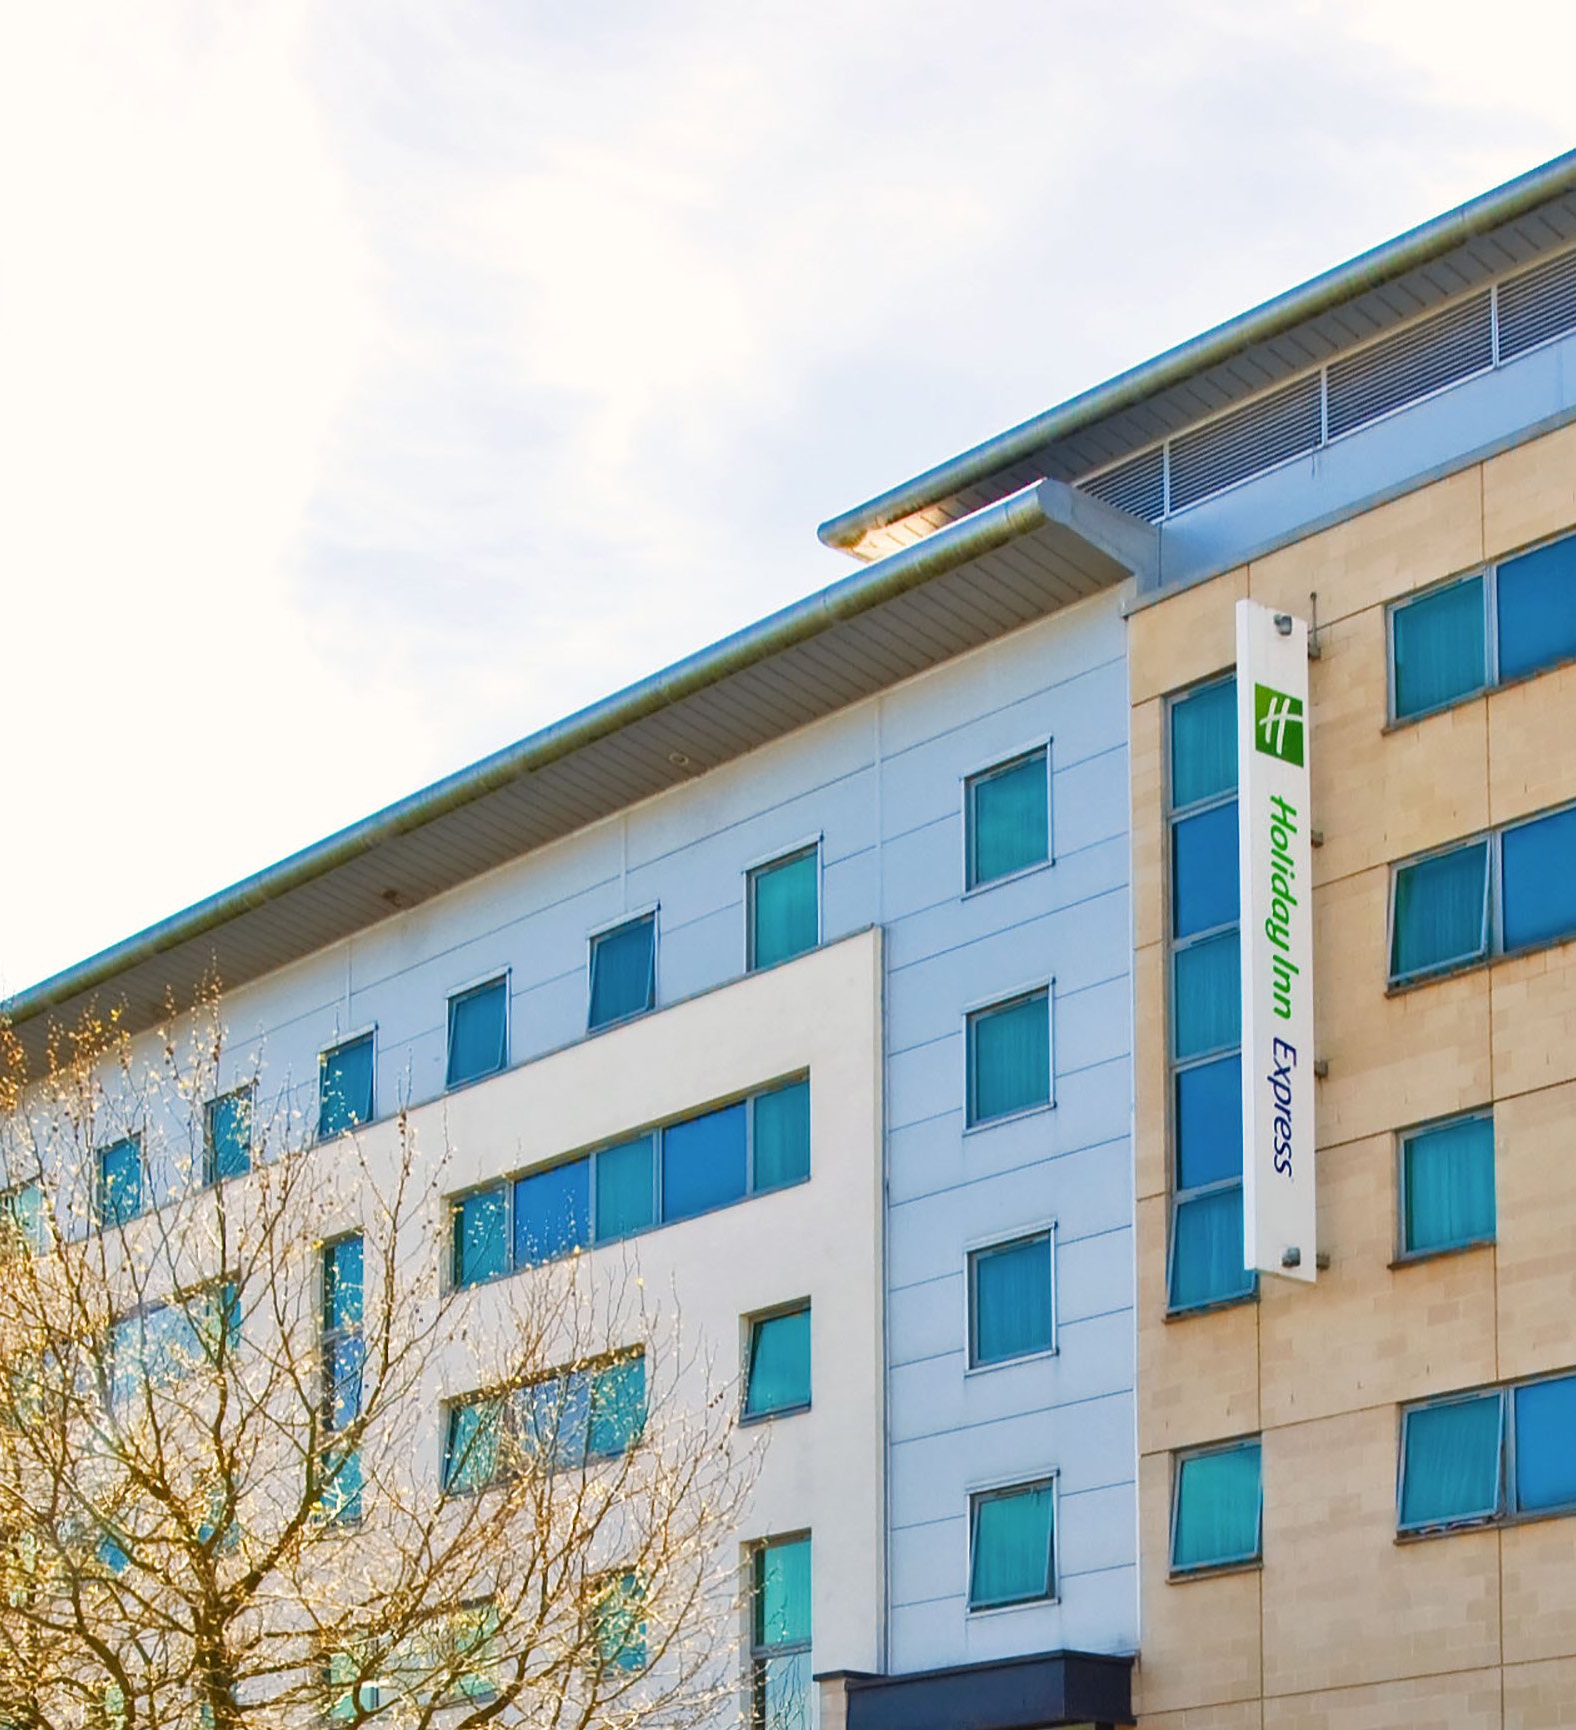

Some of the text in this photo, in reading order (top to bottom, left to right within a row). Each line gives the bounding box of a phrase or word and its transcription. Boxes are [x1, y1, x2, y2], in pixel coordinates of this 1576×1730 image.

[1265, 794, 1300, 1179] Holiday Inn Express
